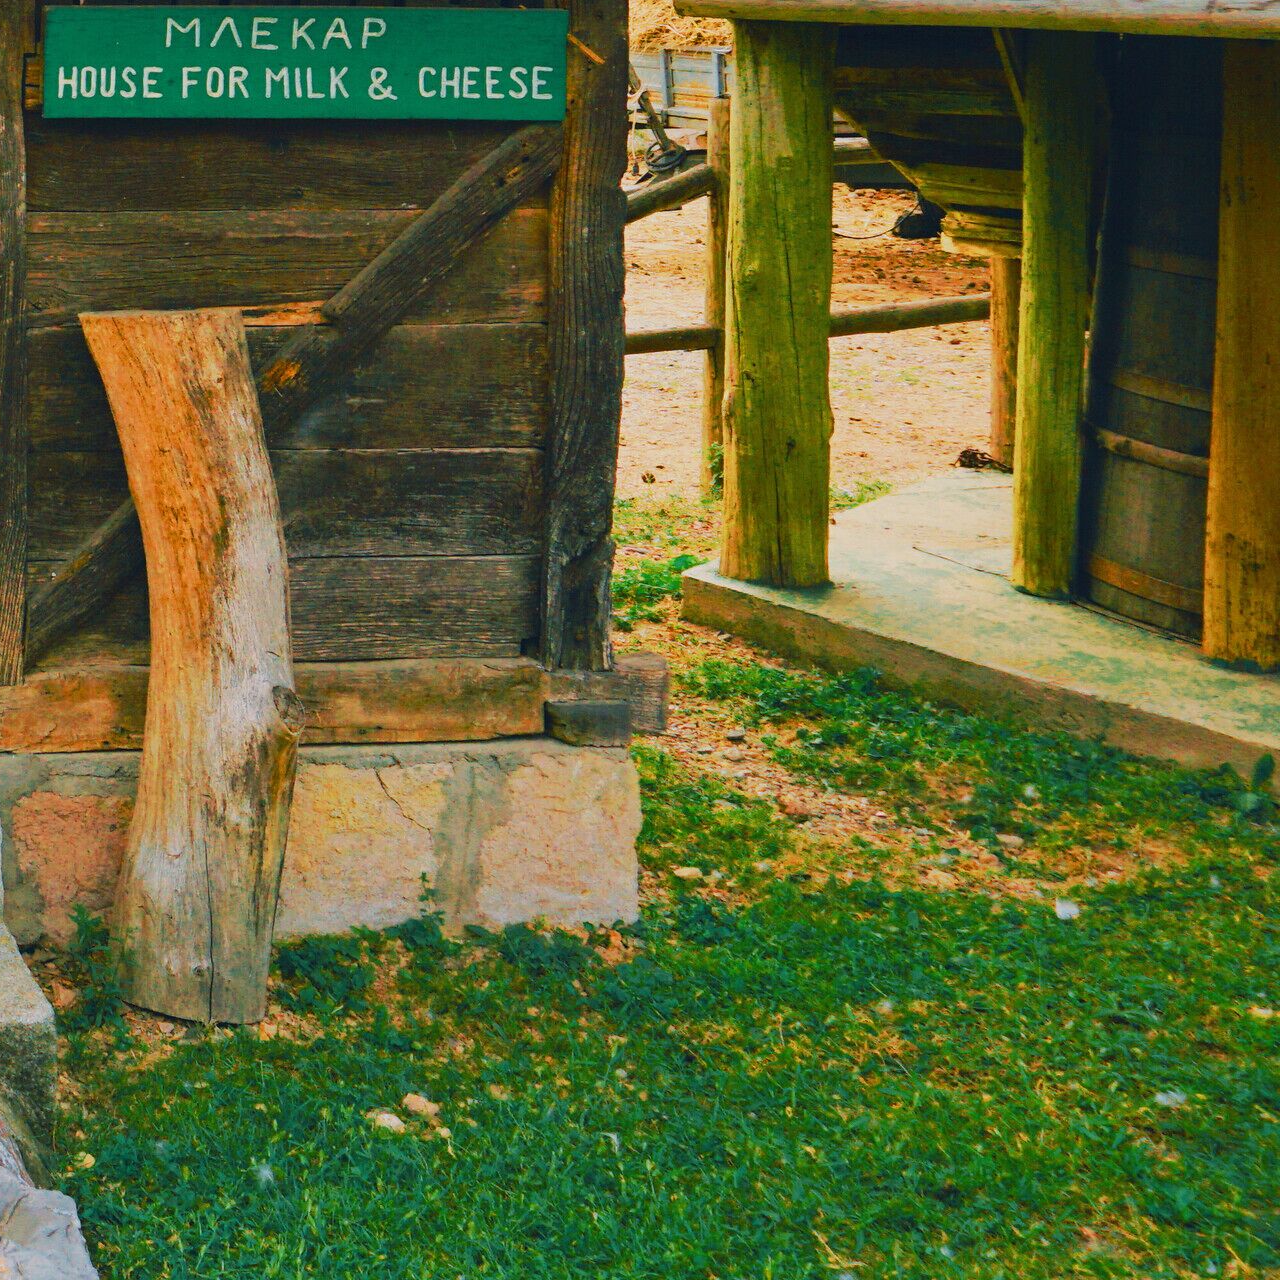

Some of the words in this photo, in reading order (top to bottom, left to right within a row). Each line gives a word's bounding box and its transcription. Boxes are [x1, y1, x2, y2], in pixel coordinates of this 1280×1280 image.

[57, 66, 164, 100] HOUSE
[181, 66, 250, 100] FOR
[265, 66, 350, 100] MILK
[368, 67, 398, 101] &
[418, 66, 554, 101] CHEESE
